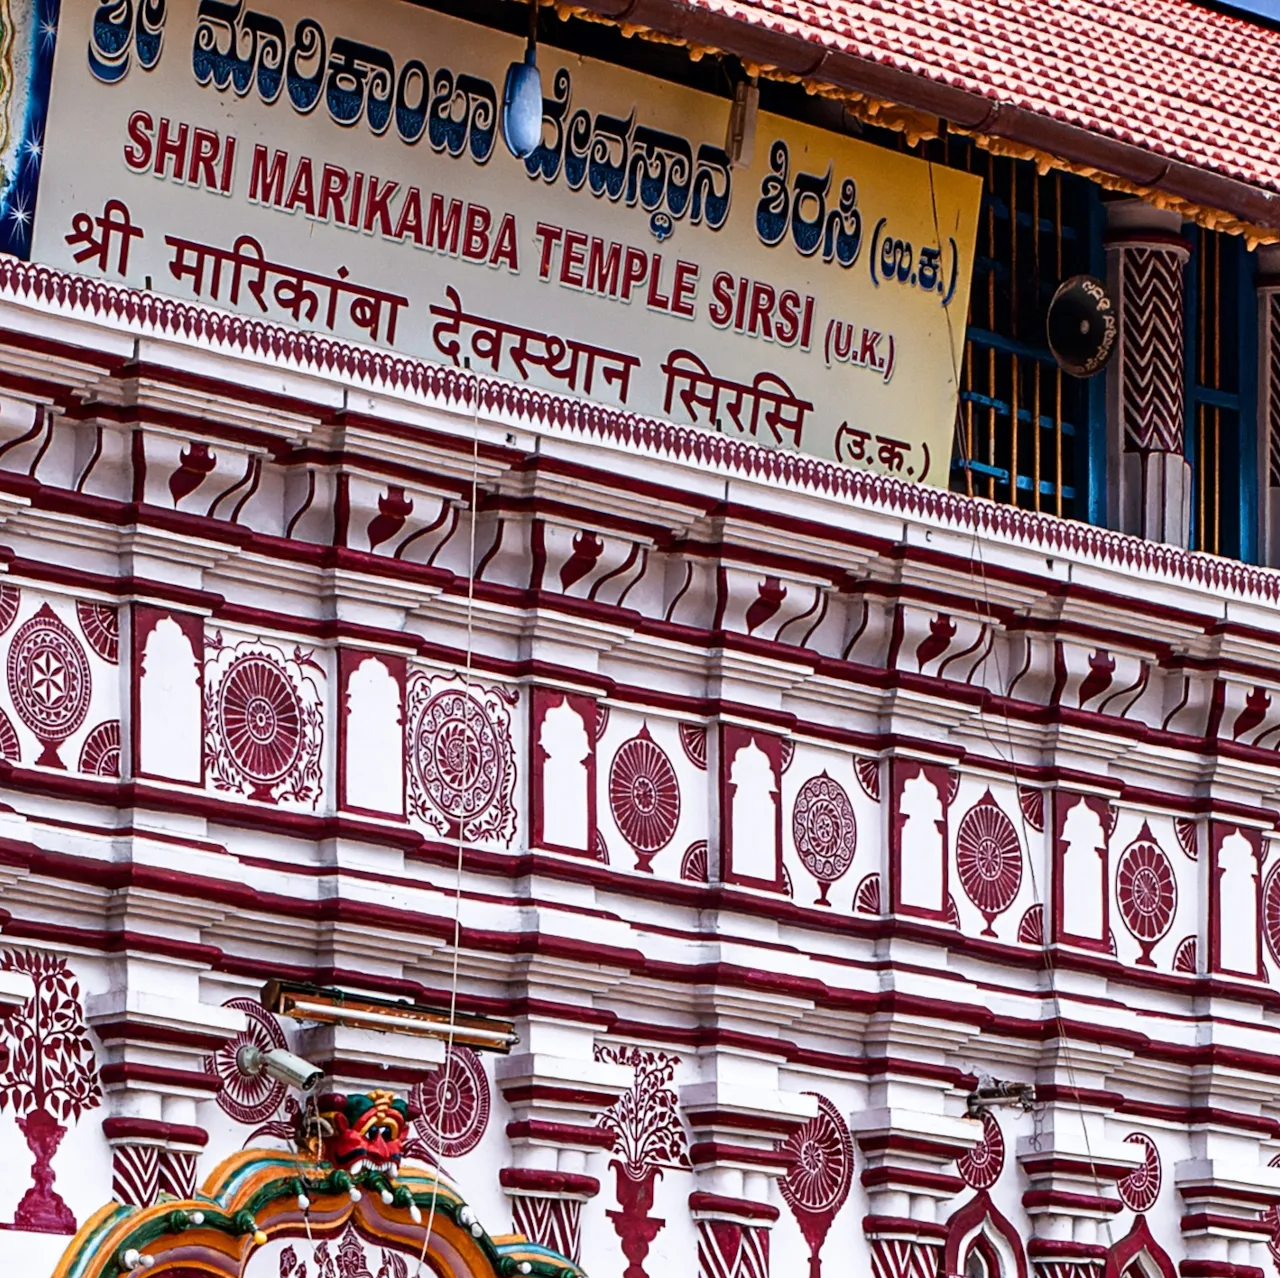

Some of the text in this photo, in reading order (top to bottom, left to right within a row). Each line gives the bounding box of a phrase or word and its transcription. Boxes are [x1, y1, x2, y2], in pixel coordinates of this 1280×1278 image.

[124, 110, 895, 383] SHRI MARIKAMBA TEMPLE SIRSI (U.K.)
[192, 0, 498, 164] ಮಾರಿಕಾಂಬಾ
[523, 67, 732, 242] ದೇವಸ್ಥಾನ
[755, 139, 863, 267] ಶಿರಸಿ
[64, 199, 931, 484] श्री मारिकांबा देवस्थान सिरसि (उ.क.)
